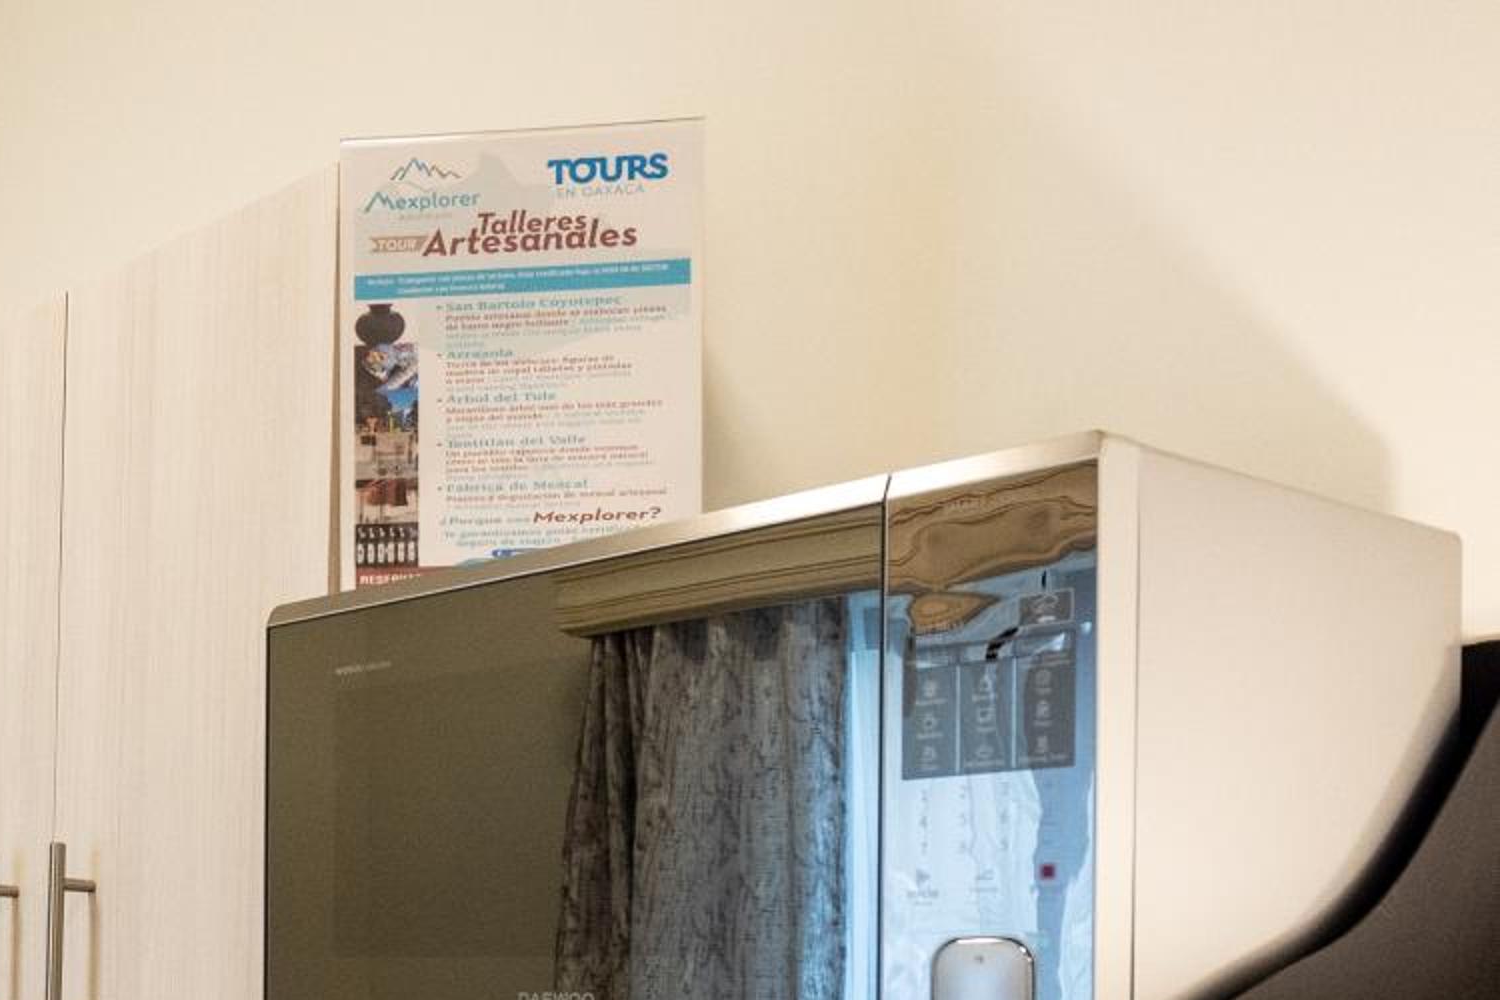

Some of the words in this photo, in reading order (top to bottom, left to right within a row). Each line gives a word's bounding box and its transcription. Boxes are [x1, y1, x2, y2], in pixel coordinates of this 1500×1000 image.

[548, 153, 669, 185] TOURS
[582, 184, 644, 197] OAXACA
[364, 191, 480, 213] Mexplorer
[478, 209, 587, 235] Talleres
[376, 238, 419, 251] TOUR
[422, 219, 638, 257] Artesanales
[446, 302, 474, 311] San
[533, 507, 662, 525] Mexplorer?
